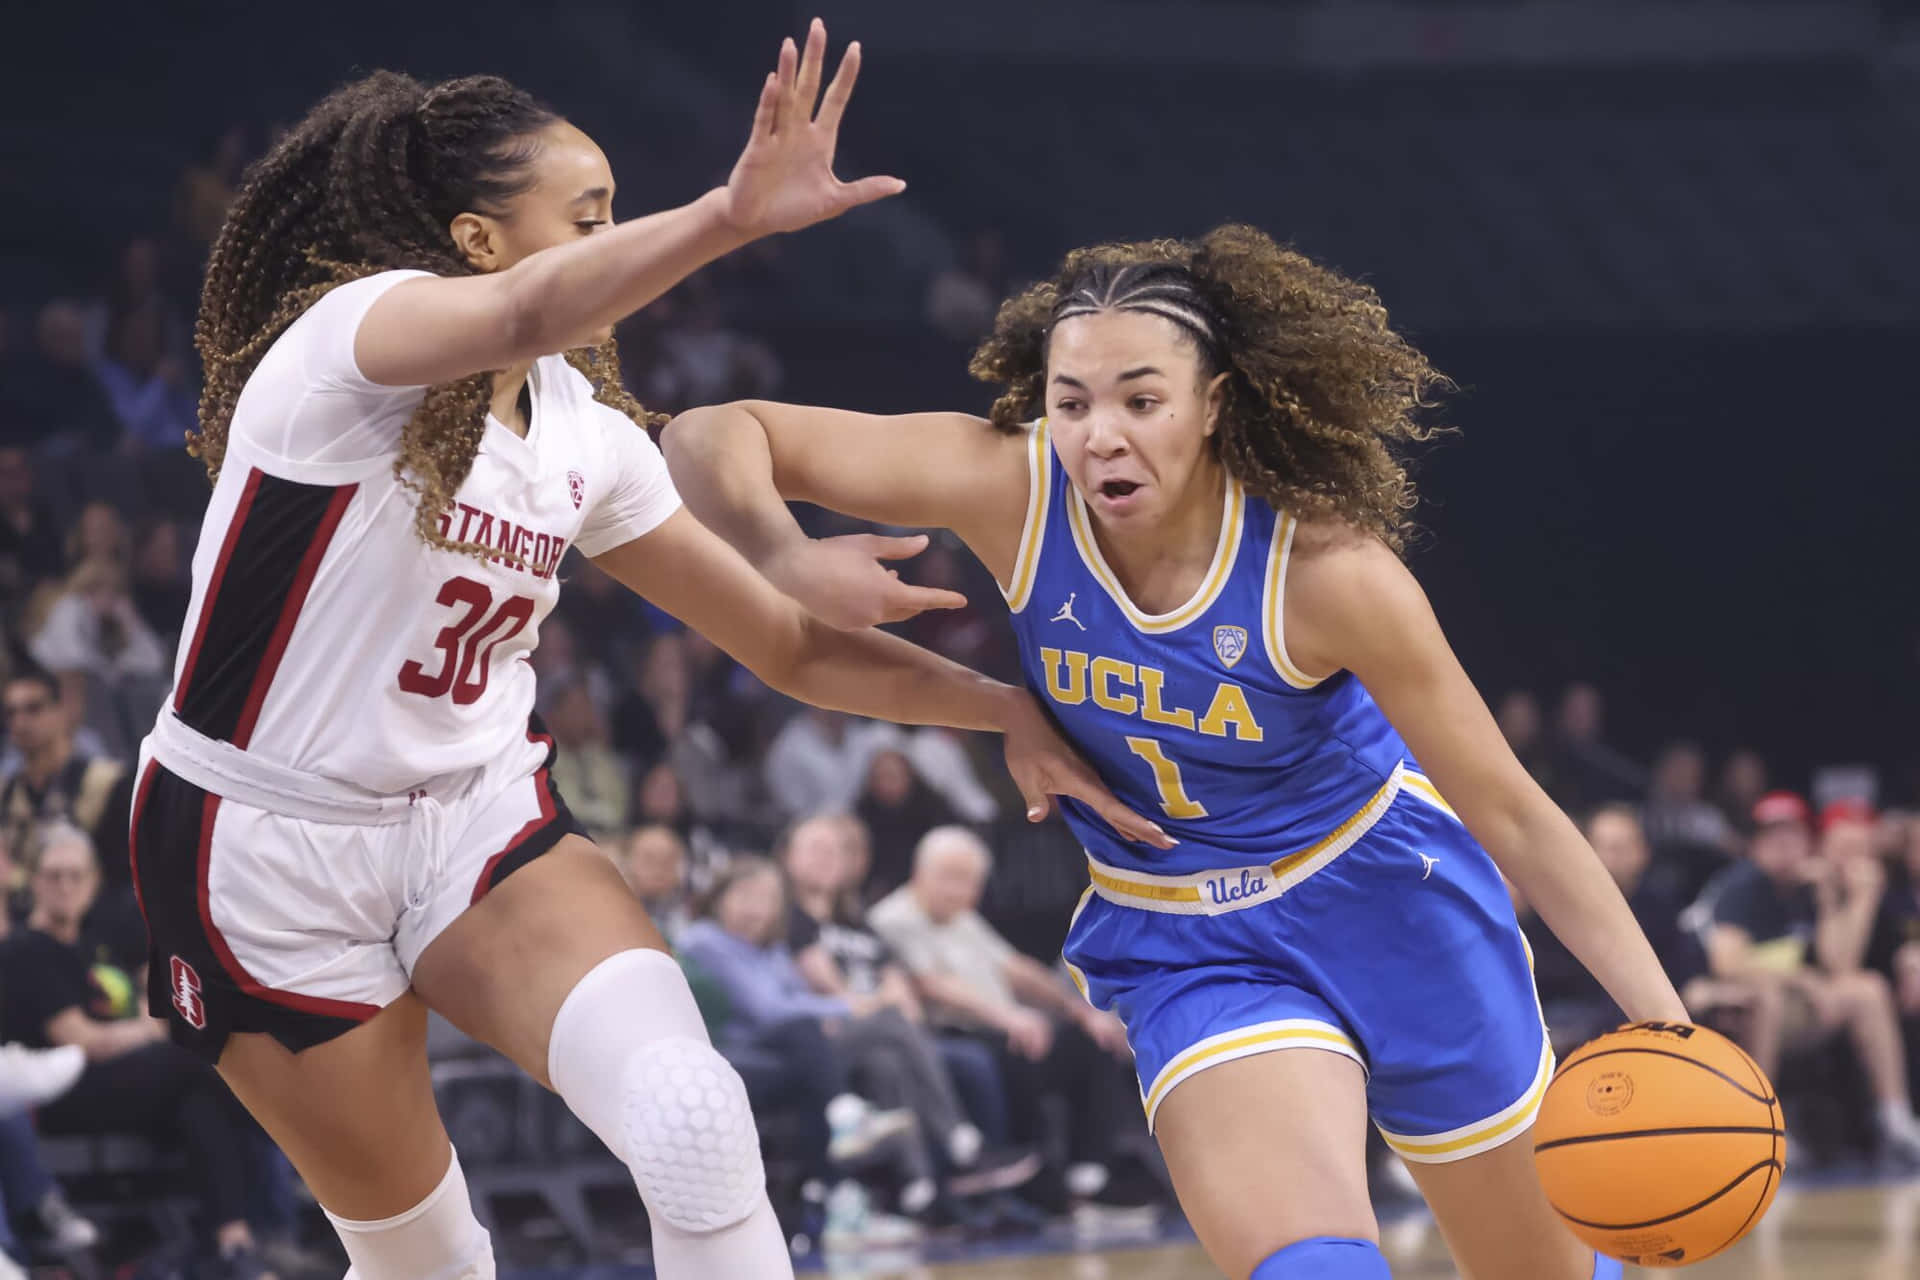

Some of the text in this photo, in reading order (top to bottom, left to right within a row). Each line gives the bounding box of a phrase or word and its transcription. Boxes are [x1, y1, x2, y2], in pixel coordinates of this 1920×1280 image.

[397, 575, 536, 705] 30
[1220, 643, 1238, 660] 12
[1039, 646, 1264, 743] UCLA
[1124, 735, 1209, 819] 1
[1206, 869, 1268, 904] Ucla
